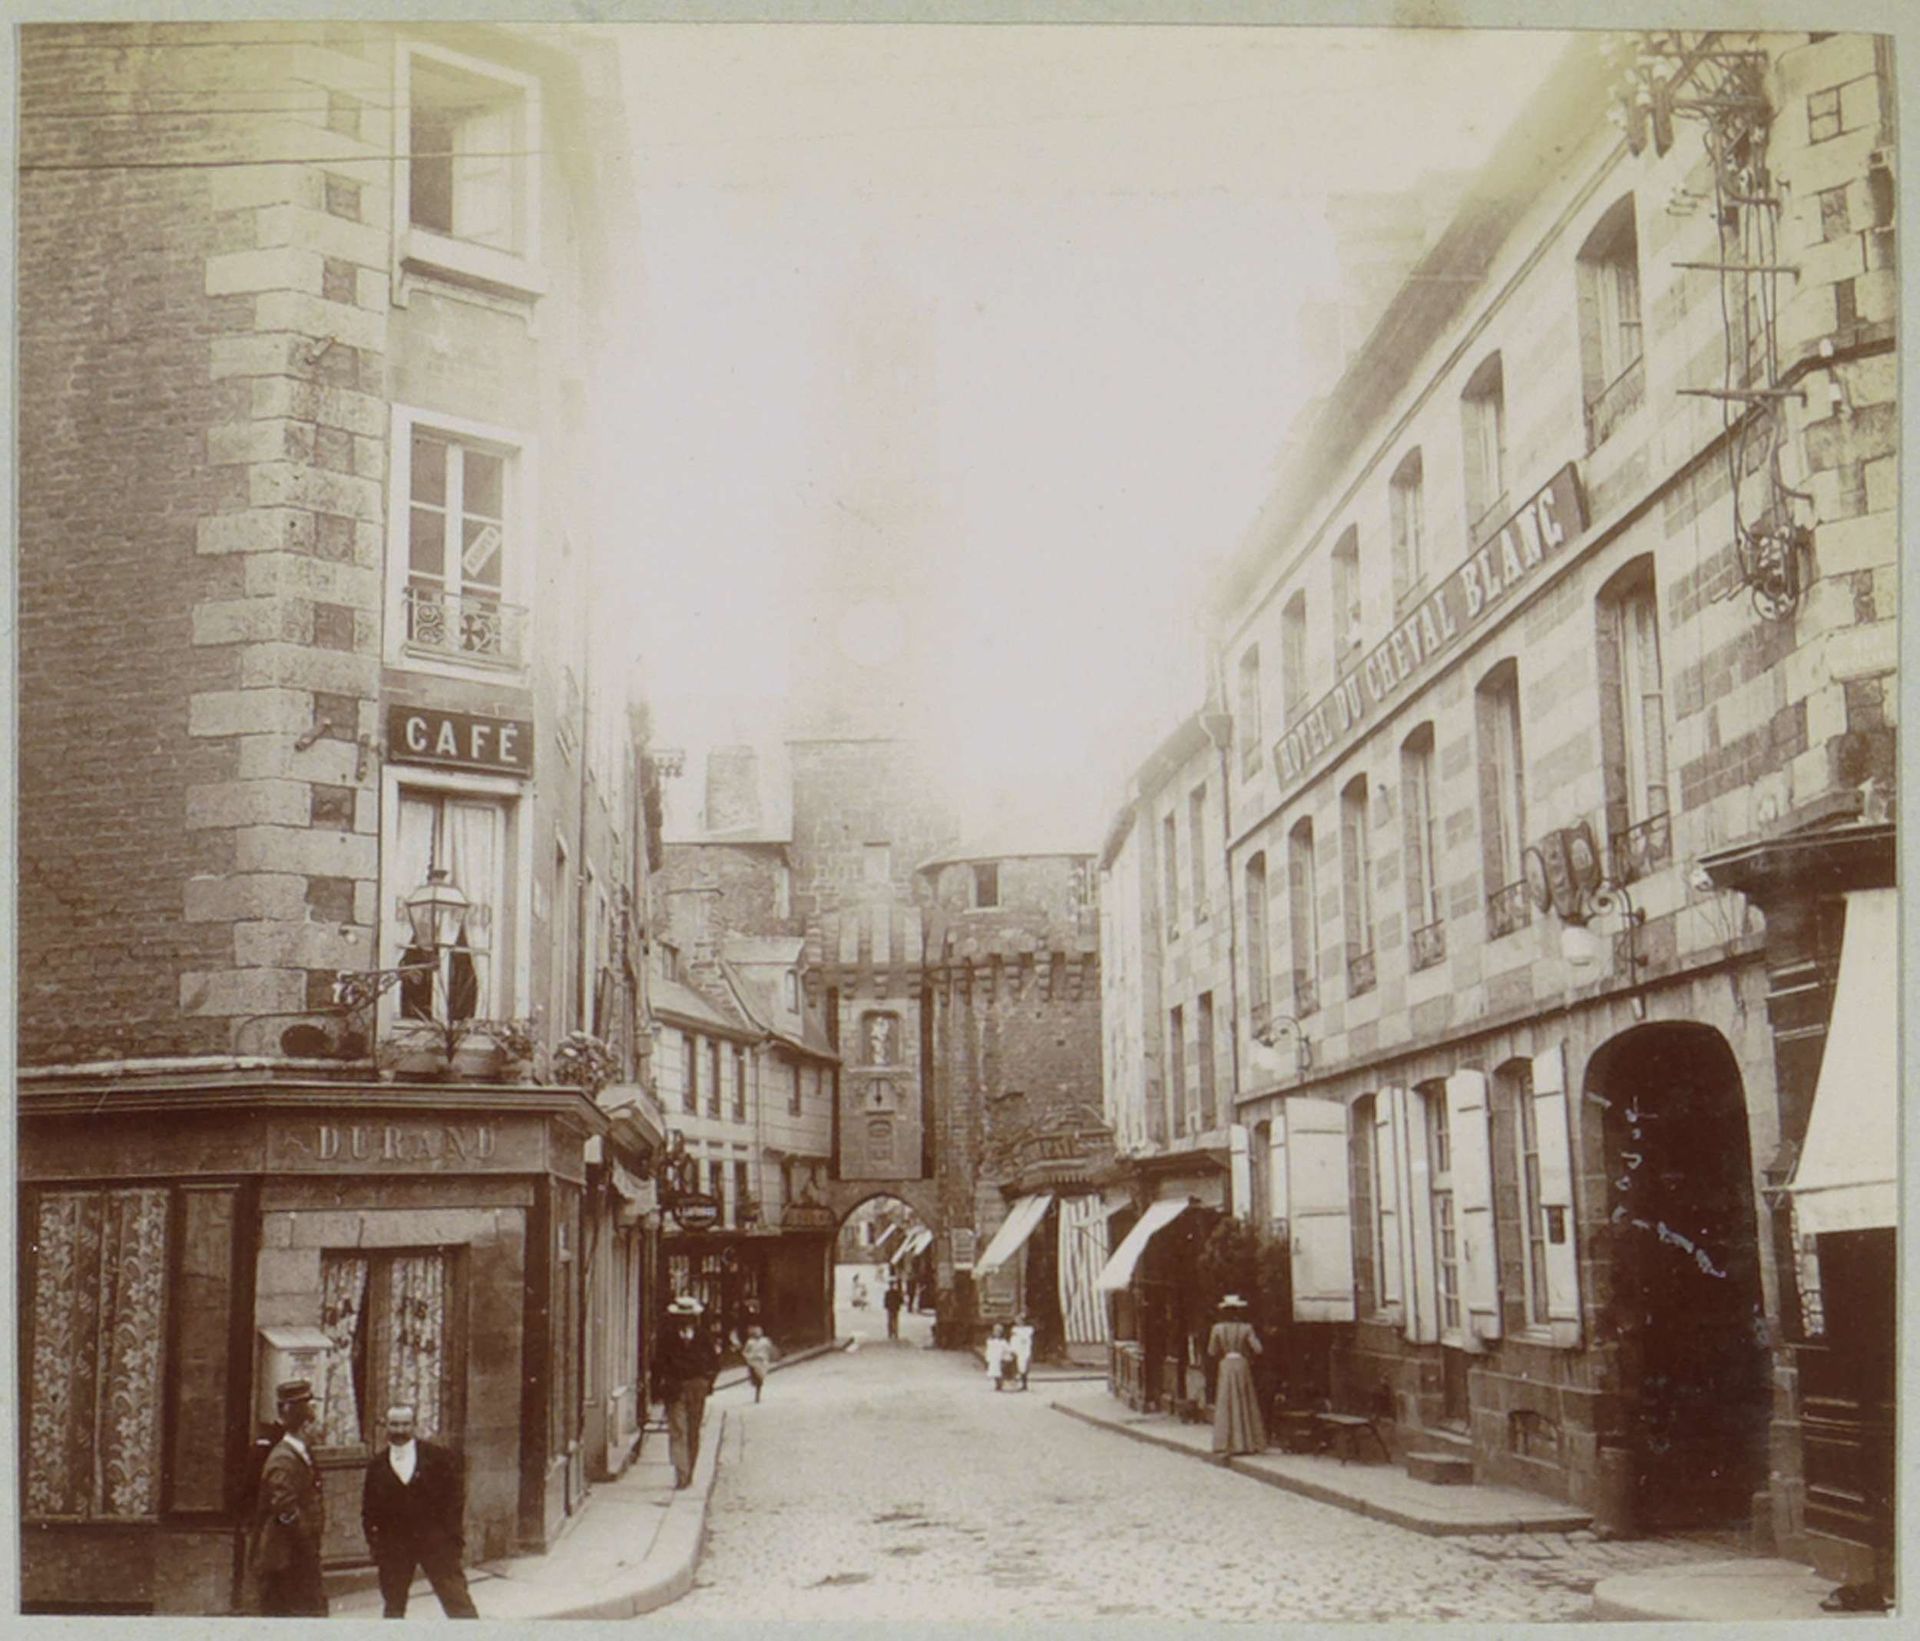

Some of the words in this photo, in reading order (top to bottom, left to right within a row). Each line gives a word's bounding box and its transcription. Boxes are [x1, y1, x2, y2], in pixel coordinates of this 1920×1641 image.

[1334, 676, 1365, 732] DU
[1366, 592, 1457, 703] CHEVAL
[1459, 488, 1564, 618] BLANC
[406, 717, 518, 762] CAFÉ
[317, 1125, 496, 1160] DURAND
